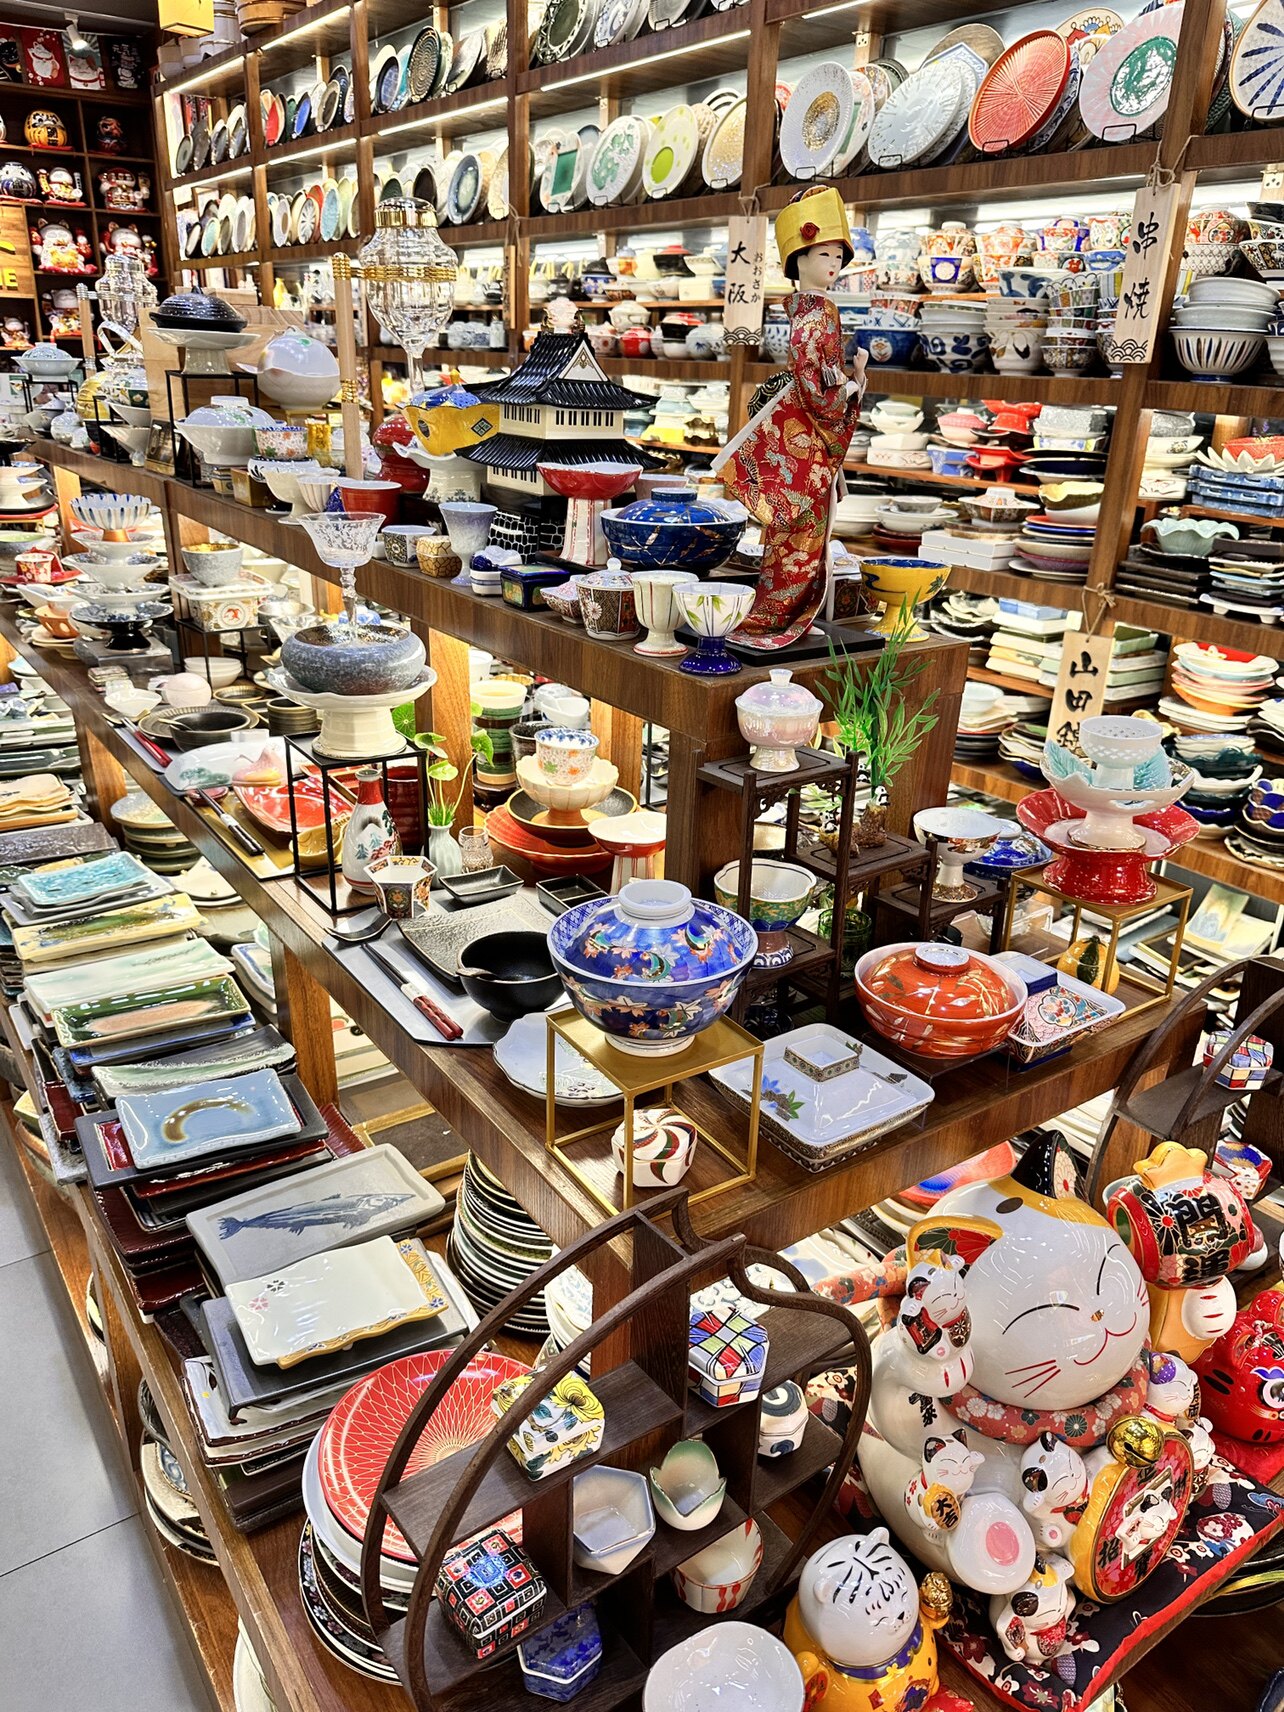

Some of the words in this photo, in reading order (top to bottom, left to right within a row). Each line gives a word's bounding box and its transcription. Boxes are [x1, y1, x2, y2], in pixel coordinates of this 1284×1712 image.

[728, 241, 750, 304] 大阪
[750, 252, 763, 303] おおさか
[1123, 211, 1160, 321] 串焼
[935, 1497, 959, 1528] 大吉
